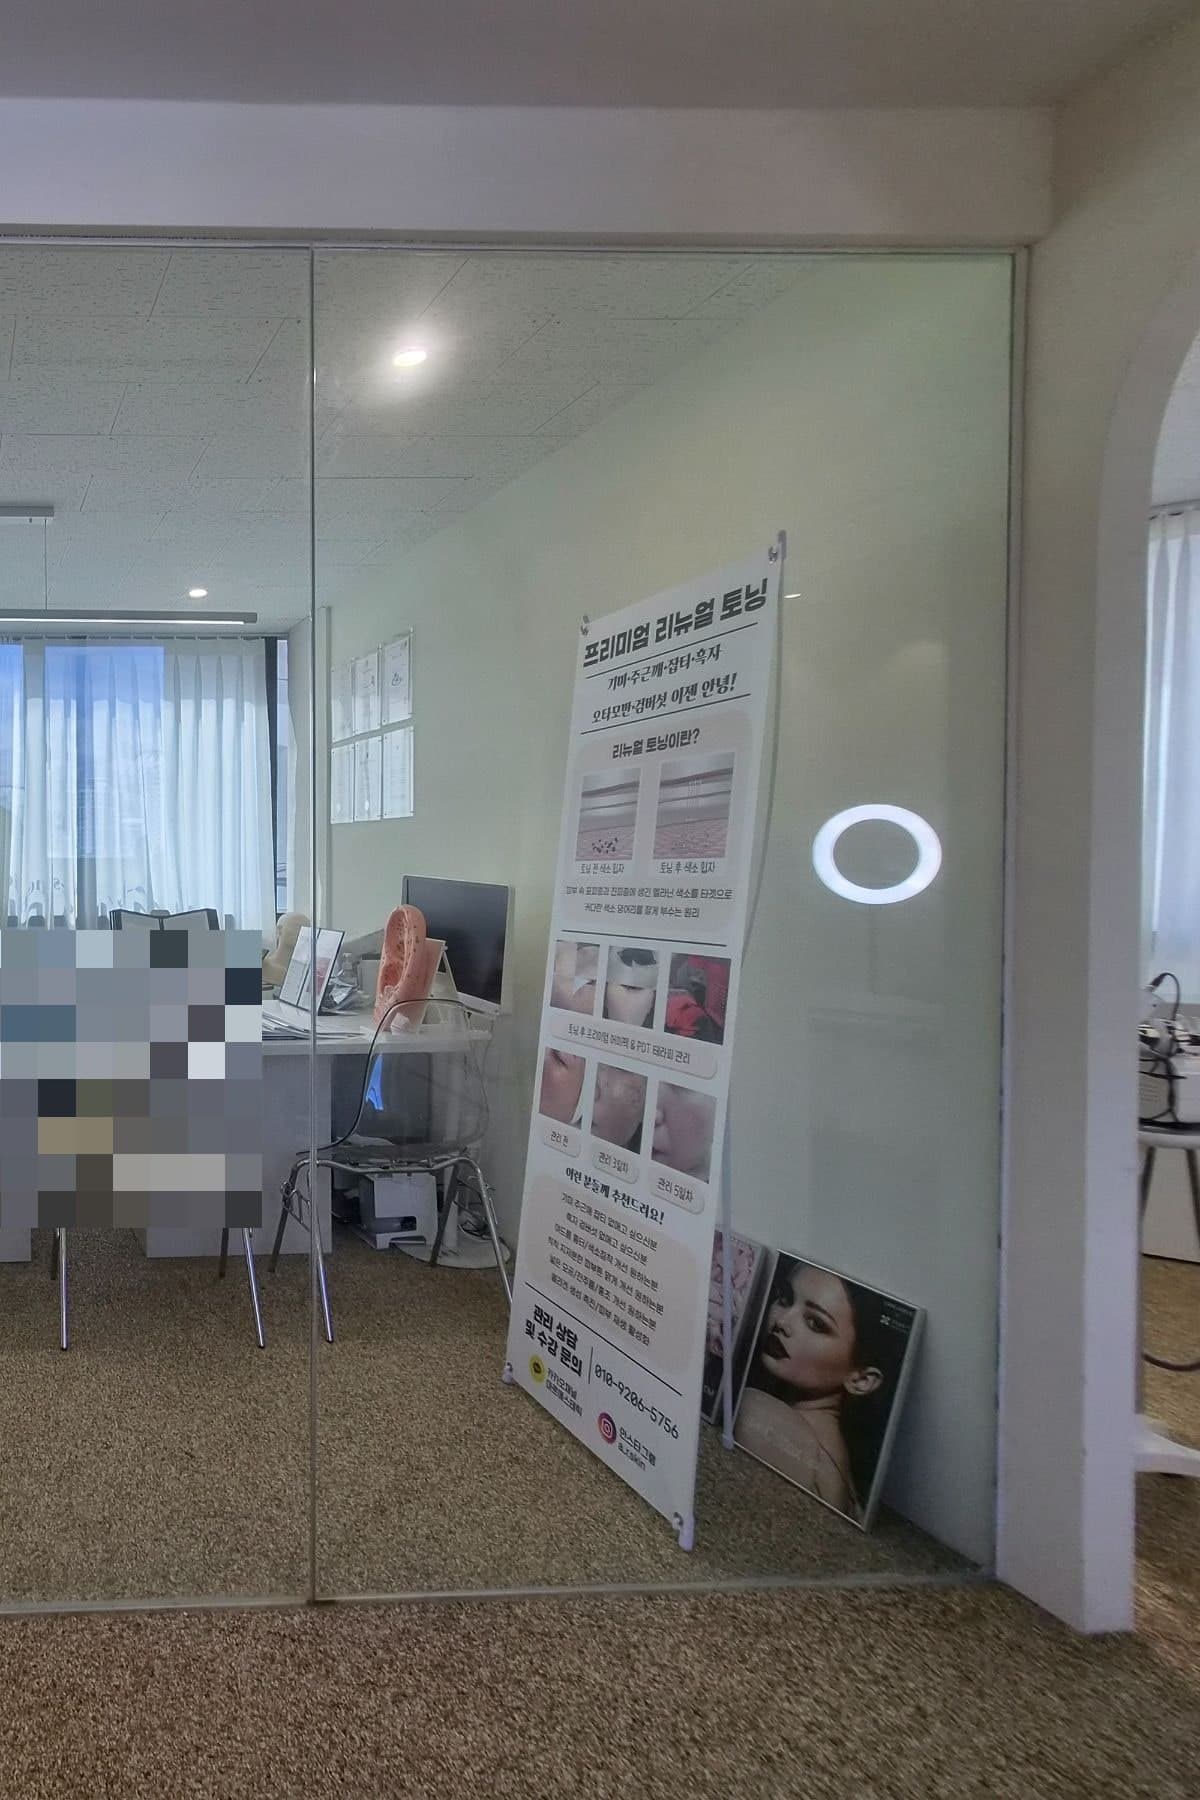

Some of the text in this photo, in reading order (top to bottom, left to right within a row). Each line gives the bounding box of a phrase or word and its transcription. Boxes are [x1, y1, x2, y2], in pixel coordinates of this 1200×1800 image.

[583, 577, 768, 668] 프리미엄 리뉴얼 토닝
[671, 682, 698, 705] 이젠
[701, 672, 738, 698] 안녕!
[612, 727, 701, 759] 리뉴얼 토닝이란?
[660, 862, 673, 874] 토닝
[684, 861, 699, 873] 색소
[701, 861, 715, 874] 입자
[675, 888, 698, 899] 색소를
[598, 1151, 612, 1166] 관리
[565, 1166, 665, 1225] 이런 분들께 추천드려요!
[657, 1177, 672, 1194] 관리
[533, 1303, 578, 1351] 관리 상담
[525, 1319, 536, 1340] 및
[560, 1346, 583, 1378] 문의
[594, 1363, 679, 1440] 010-9206-5756
[619, 1426, 656, 1467] 인스타그램
